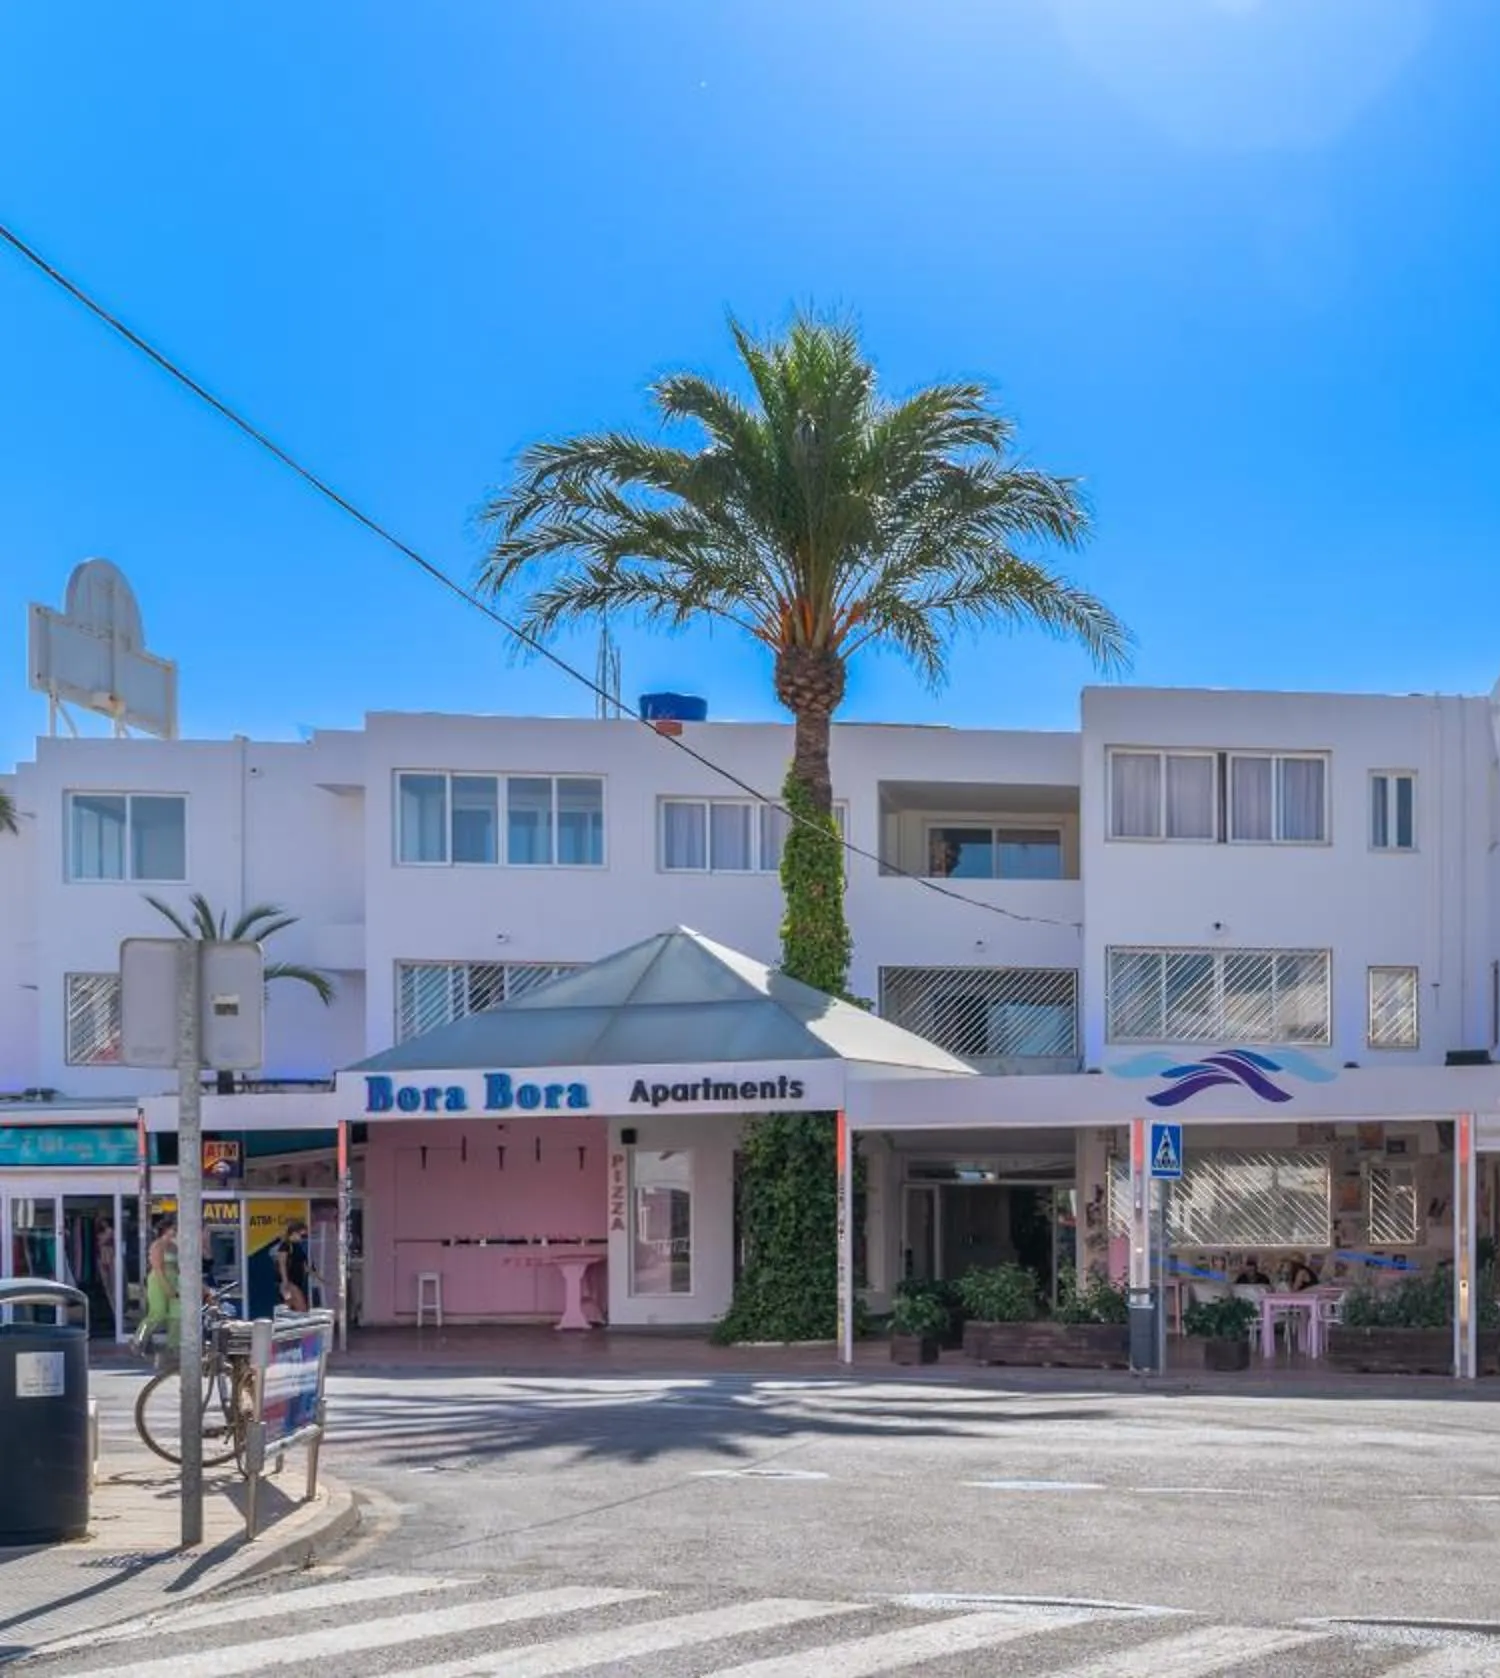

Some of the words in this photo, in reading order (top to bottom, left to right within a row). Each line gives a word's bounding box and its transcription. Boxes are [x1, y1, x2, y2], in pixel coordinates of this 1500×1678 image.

[364, 1075, 468, 1112] Bora
[483, 1072, 590, 1110] Bora
[628, 1075, 805, 1108] Apartments
[203, 1203, 239, 1220] ATM
[610, 1154, 625, 1231] PIZZA
